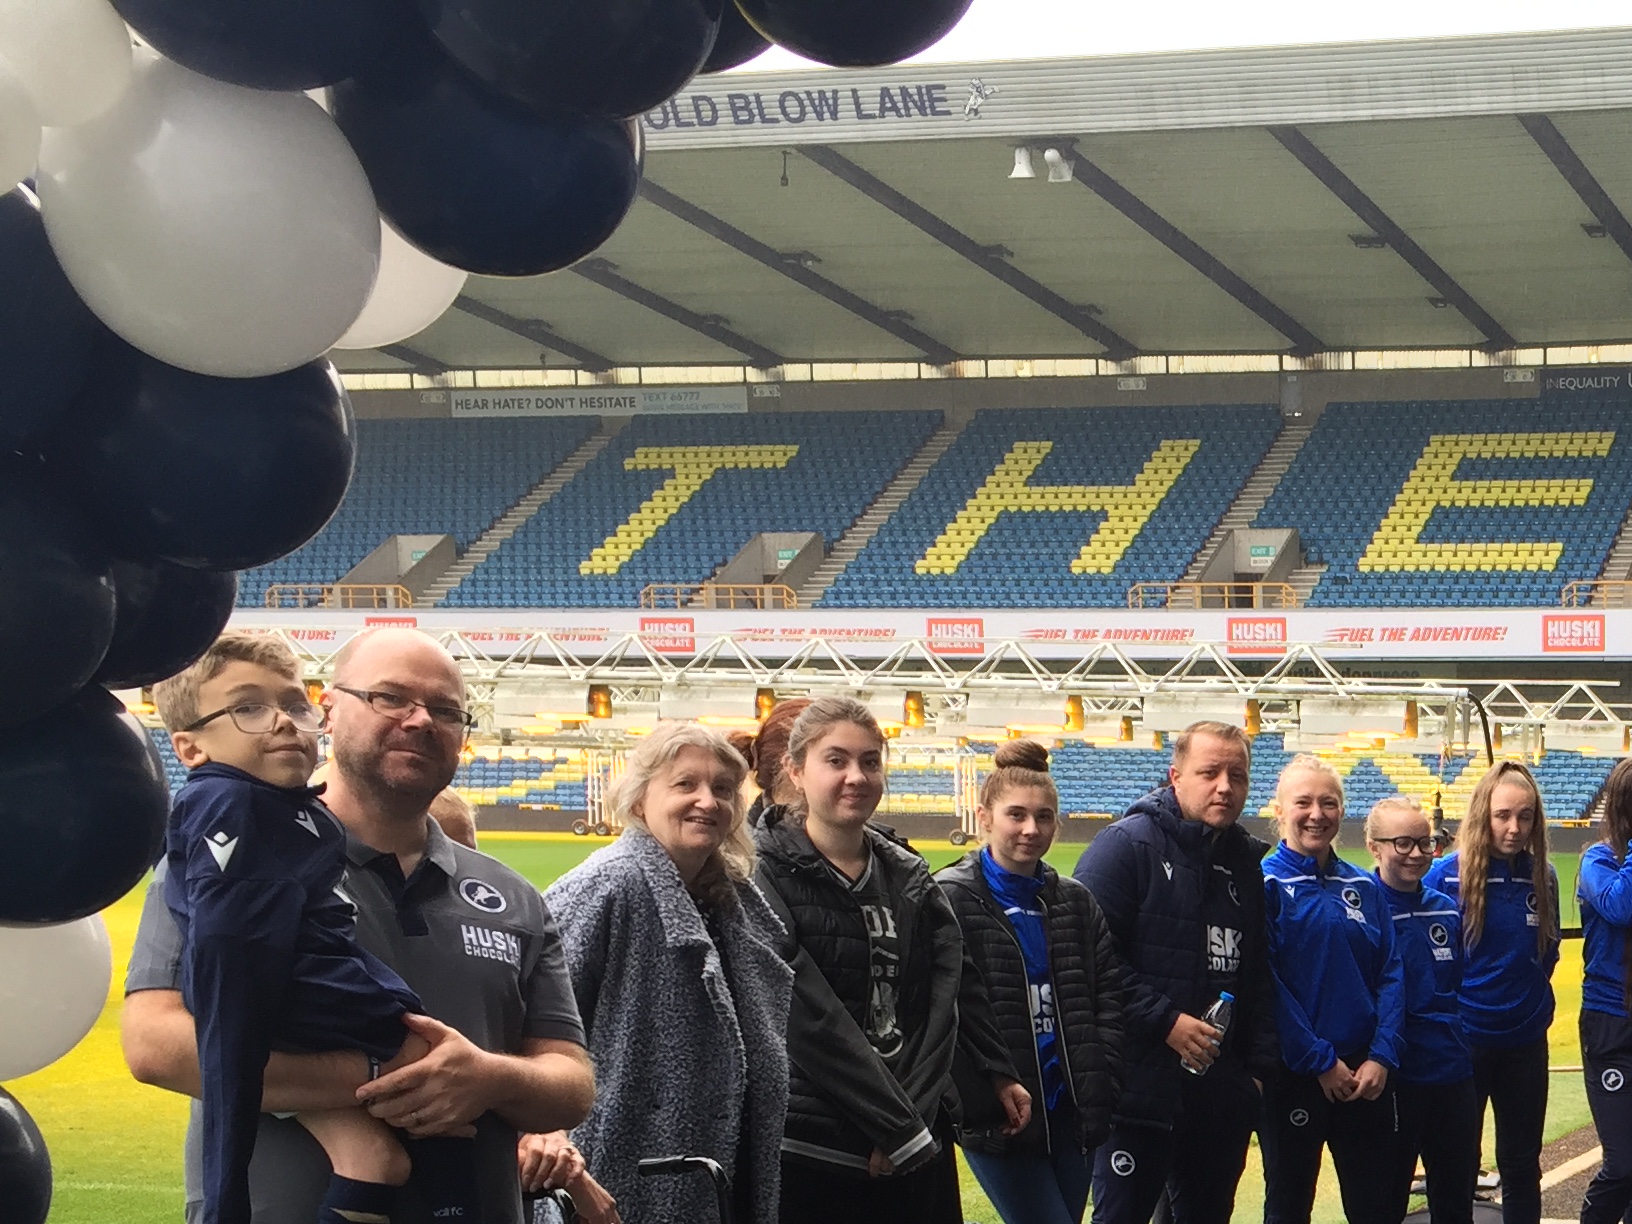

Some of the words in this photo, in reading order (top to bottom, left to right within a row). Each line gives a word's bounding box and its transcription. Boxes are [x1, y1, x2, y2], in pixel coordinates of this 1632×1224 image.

[645, 95, 719, 130] OLD
[727, 89, 839, 125] BLOW
[851, 84, 953, 120] LANE
[455, 398, 489, 410] HEAR
[492, 398, 531, 410] HATE?
[535, 397, 575, 409] DON'T
[579, 396, 636, 409] HESITATE
[642, 392, 667, 401] TEXT
[579, 432, 1616, 576] THE
[931, 623, 981, 638] HUSKI
[1072, 628, 1100, 641] THE
[1102, 628, 1195, 641] ADVENTURE!
[1231, 623, 1283, 640] HUSKI
[1330, 627, 1374, 642] FUEL
[1379, 627, 1408, 642] THE
[1409, 626, 1509, 642] ADVENTURE!
[1547, 620, 1601, 638] HUSKI
[1547, 638, 1601, 647] CHOCOLATE
